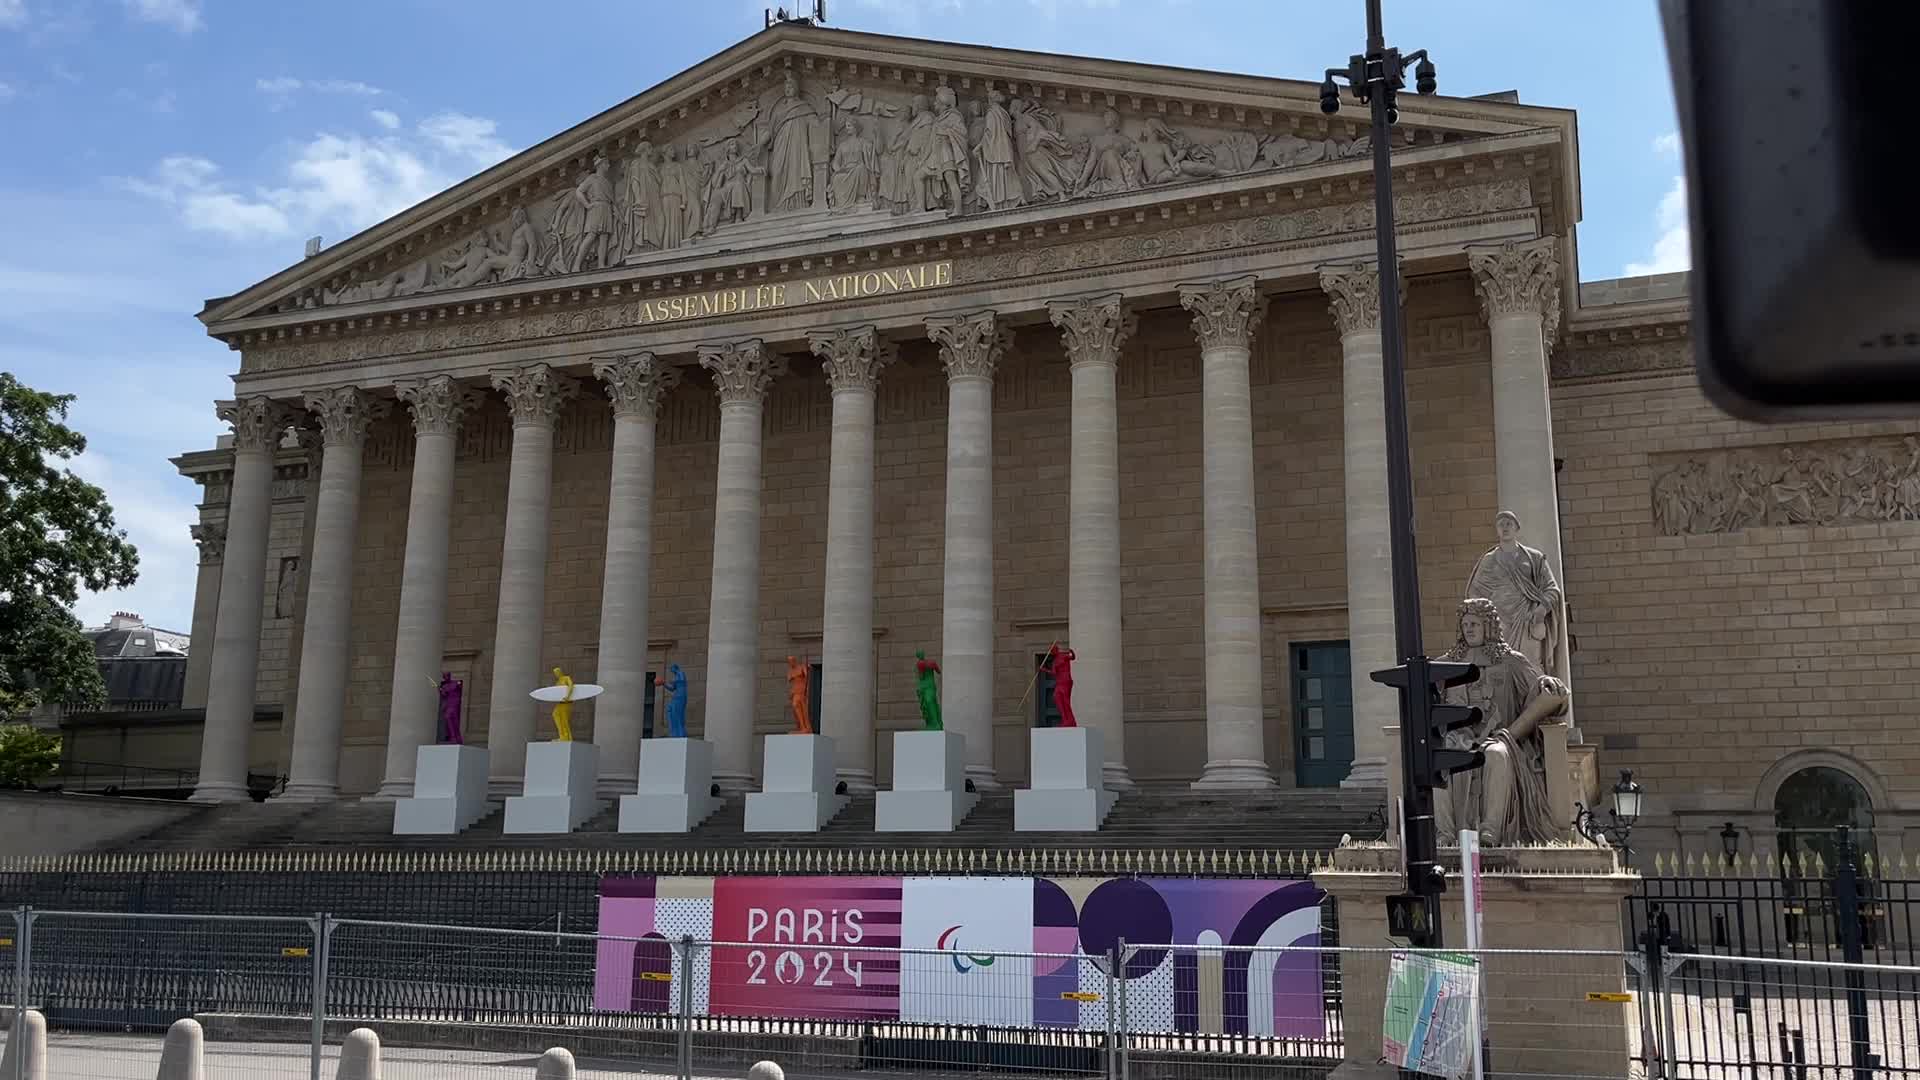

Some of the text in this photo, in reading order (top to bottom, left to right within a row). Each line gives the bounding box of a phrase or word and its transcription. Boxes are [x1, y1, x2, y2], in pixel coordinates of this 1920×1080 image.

[638, 262, 953, 324] ASSEMBLÉE NATIONALE
[746, 950, 863, 987] 2024
